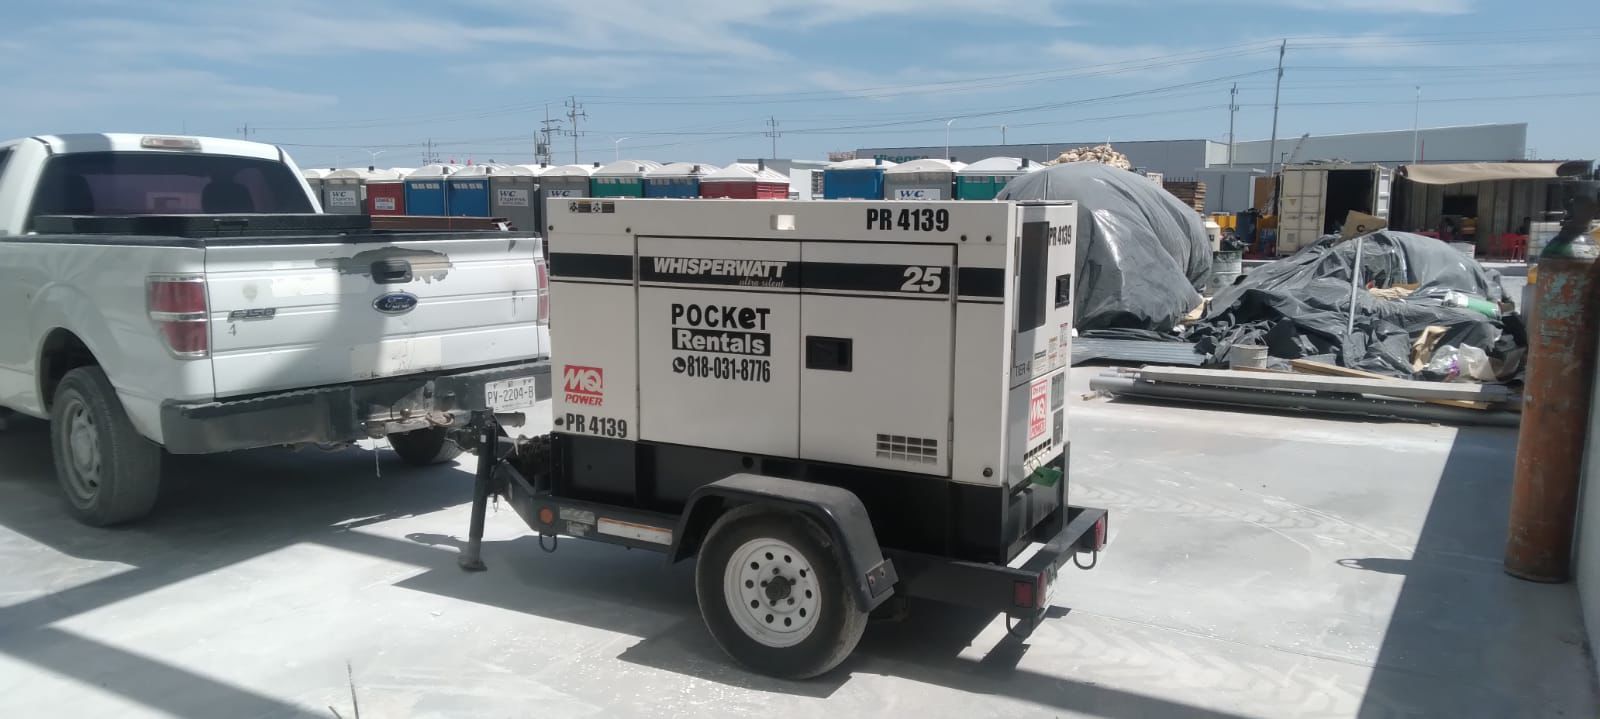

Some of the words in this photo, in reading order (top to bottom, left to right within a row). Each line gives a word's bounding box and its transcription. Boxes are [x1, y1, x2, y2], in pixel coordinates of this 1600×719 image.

[900, 190, 924, 198] WC
[867, 208, 892, 231] PR
[897, 208, 949, 232] 4139
[1057, 225, 1072, 245] 4139
[653, 257, 787, 278] WHISPERWATT
[900, 266, 942, 292] 25
[677, 330, 765, 354] Rentals
[565, 367, 603, 393] MQ
[687, 355, 770, 383] 818-031-8776
[1015, 363, 1025, 377] TIER
[487, 385, 534, 405] PV-2204-B
[565, 394, 602, 406] POWER
[566, 413, 585, 433] PR
[589, 416, 627, 438] 4139
